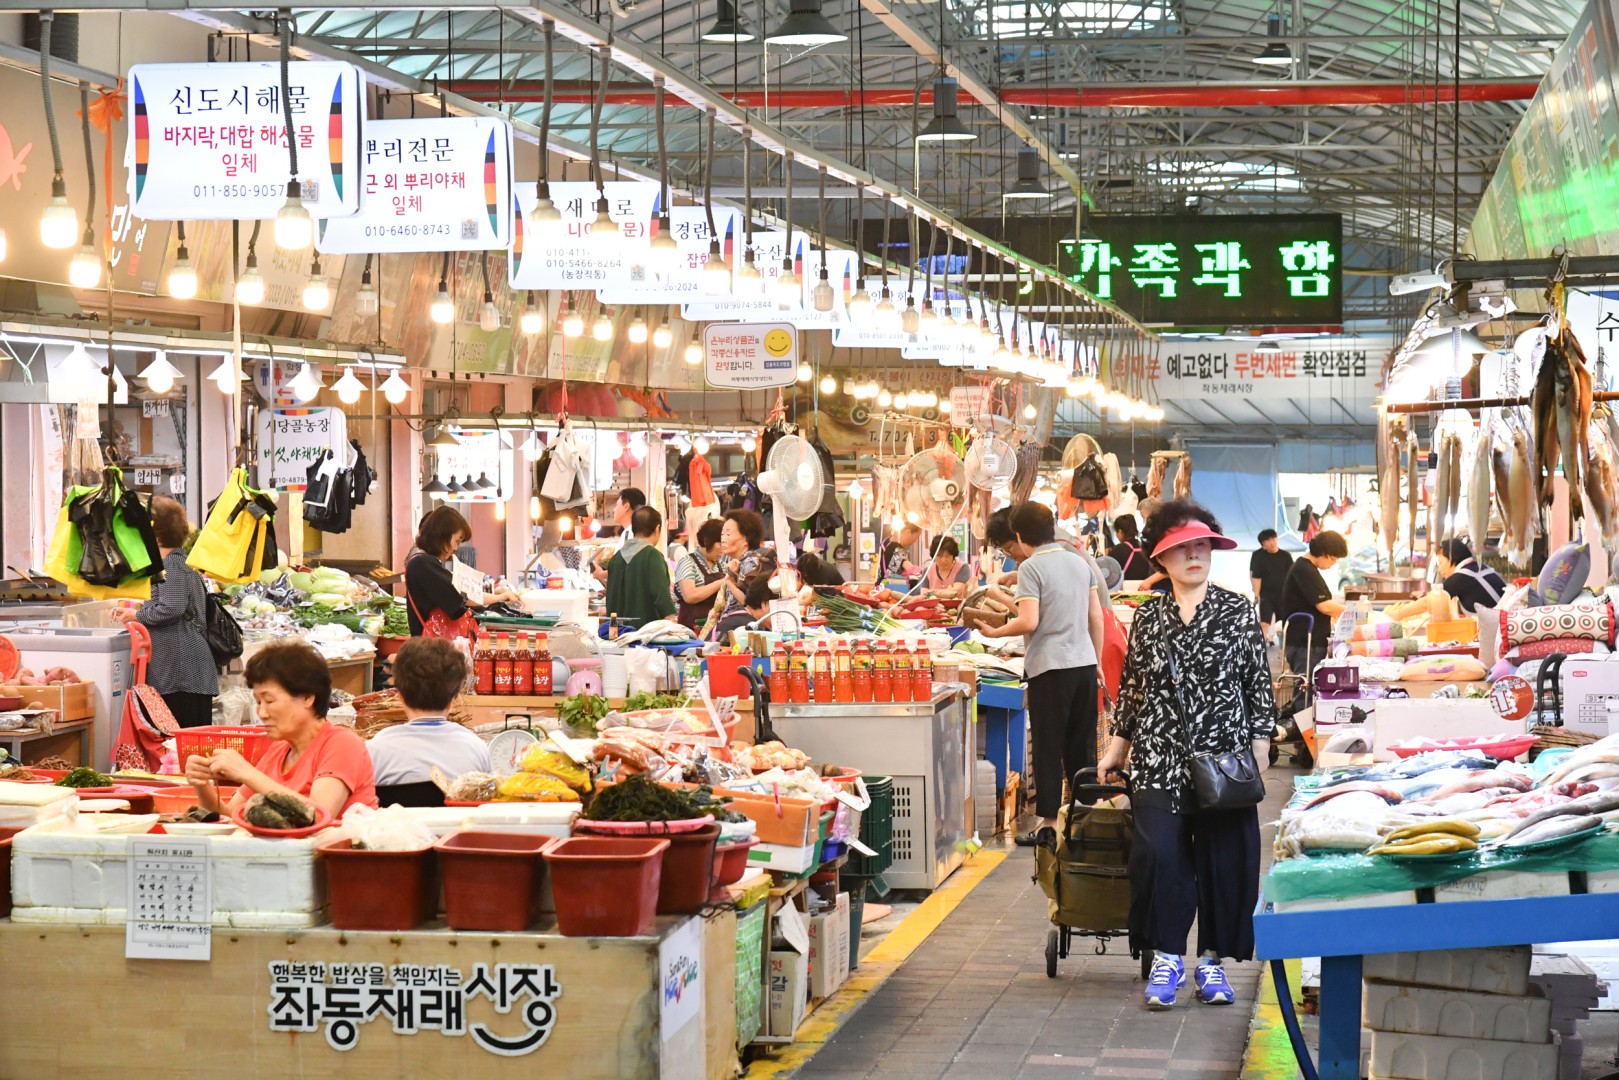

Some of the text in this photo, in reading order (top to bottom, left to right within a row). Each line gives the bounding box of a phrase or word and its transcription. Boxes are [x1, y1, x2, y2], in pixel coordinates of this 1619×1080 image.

[169, 85, 310, 114] 신도시해물
[222, 153, 257, 177] 일체
[193, 184, 284, 198] 011-850-9057
[384, 173, 398, 191] 외
[404, 172, 466, 191] 뿌리야채
[392, 195, 422, 216] 일체
[365, 224, 451, 237] 010-6460-8743
[1279, 241, 1334, 296] 함
[1166, 352, 1228, 379] 예고없다
[1234, 352, 1297, 378] 두번세번
[1302, 350, 1367, 377] 확인점검
[273, 964, 461, 987] 행복한 밥상을 책임지는
